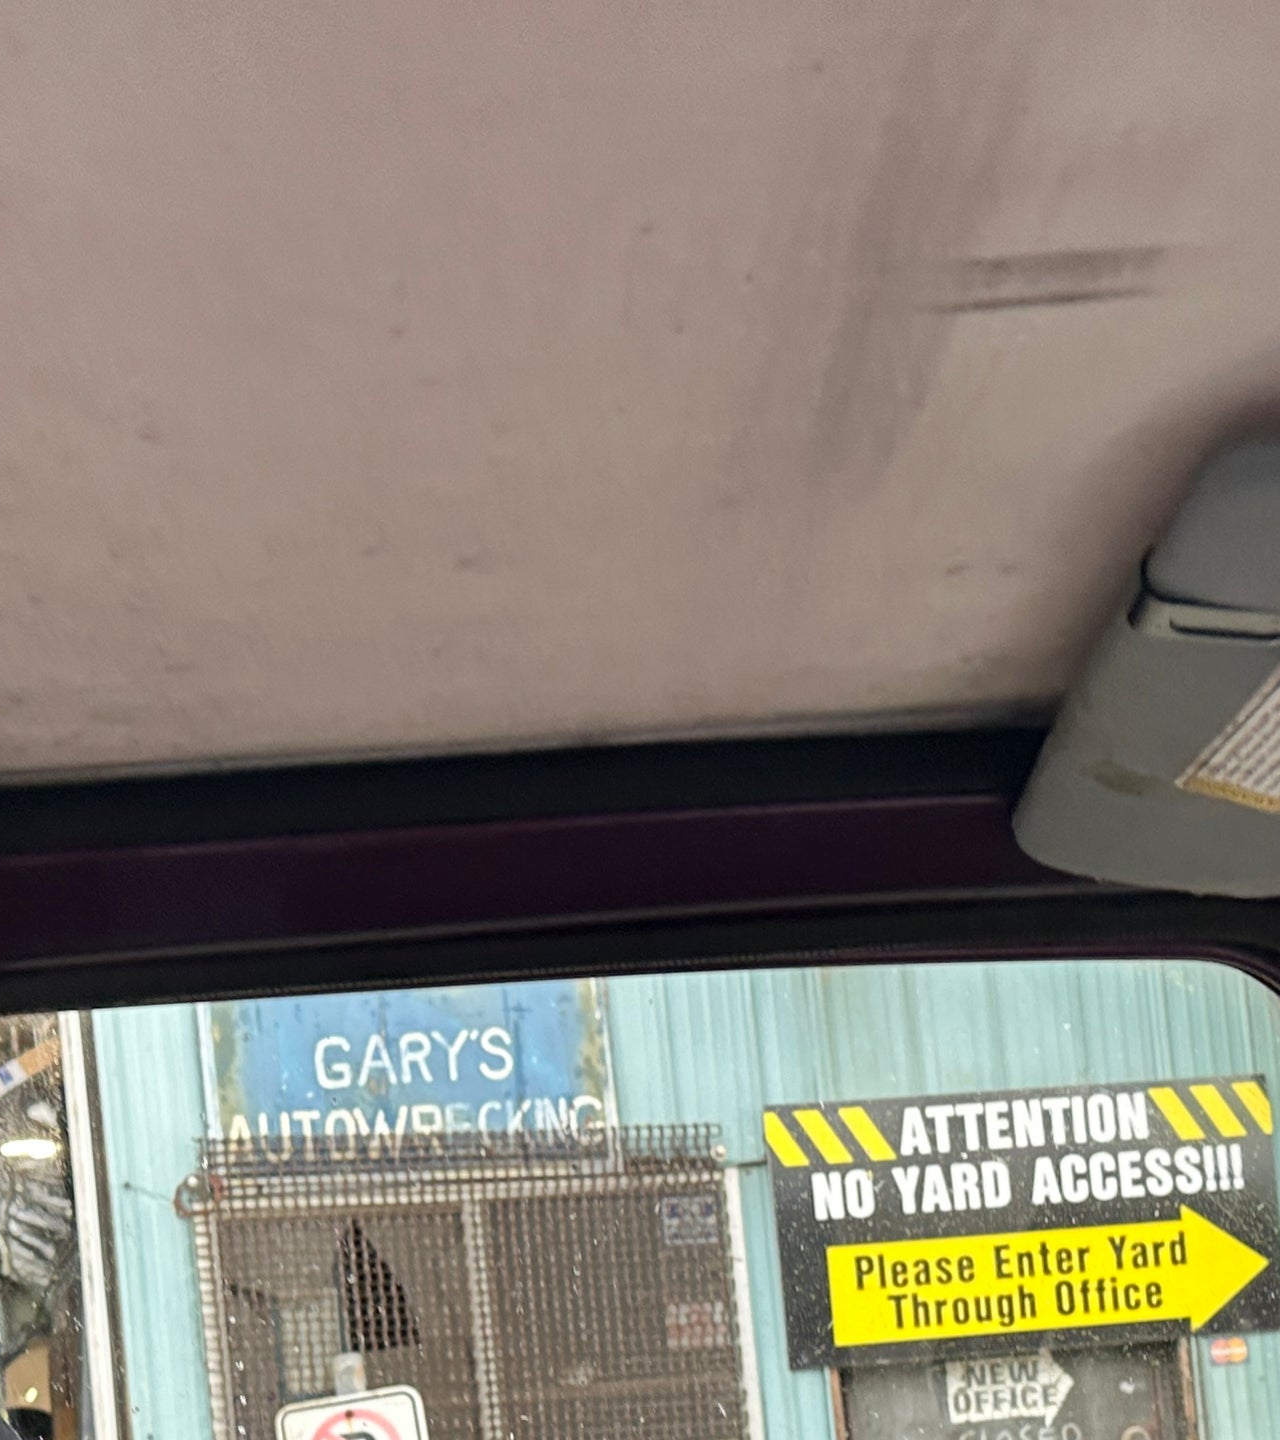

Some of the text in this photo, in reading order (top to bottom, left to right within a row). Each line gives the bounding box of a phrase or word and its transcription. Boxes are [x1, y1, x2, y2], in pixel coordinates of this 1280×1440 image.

[314, 1026, 514, 1090] GARY'S
[900, 1093, 1150, 1156] ATTENTION
[811, 1144, 1246, 1222] NO YARD ACCESS!!!
[853, 1231, 1187, 1292] Please Enter Yard
[888, 1280, 1164, 1331] Through Office
[952, 1384, 1059, 1416] OFFICE
[966, 1361, 1039, 1387] NEW
